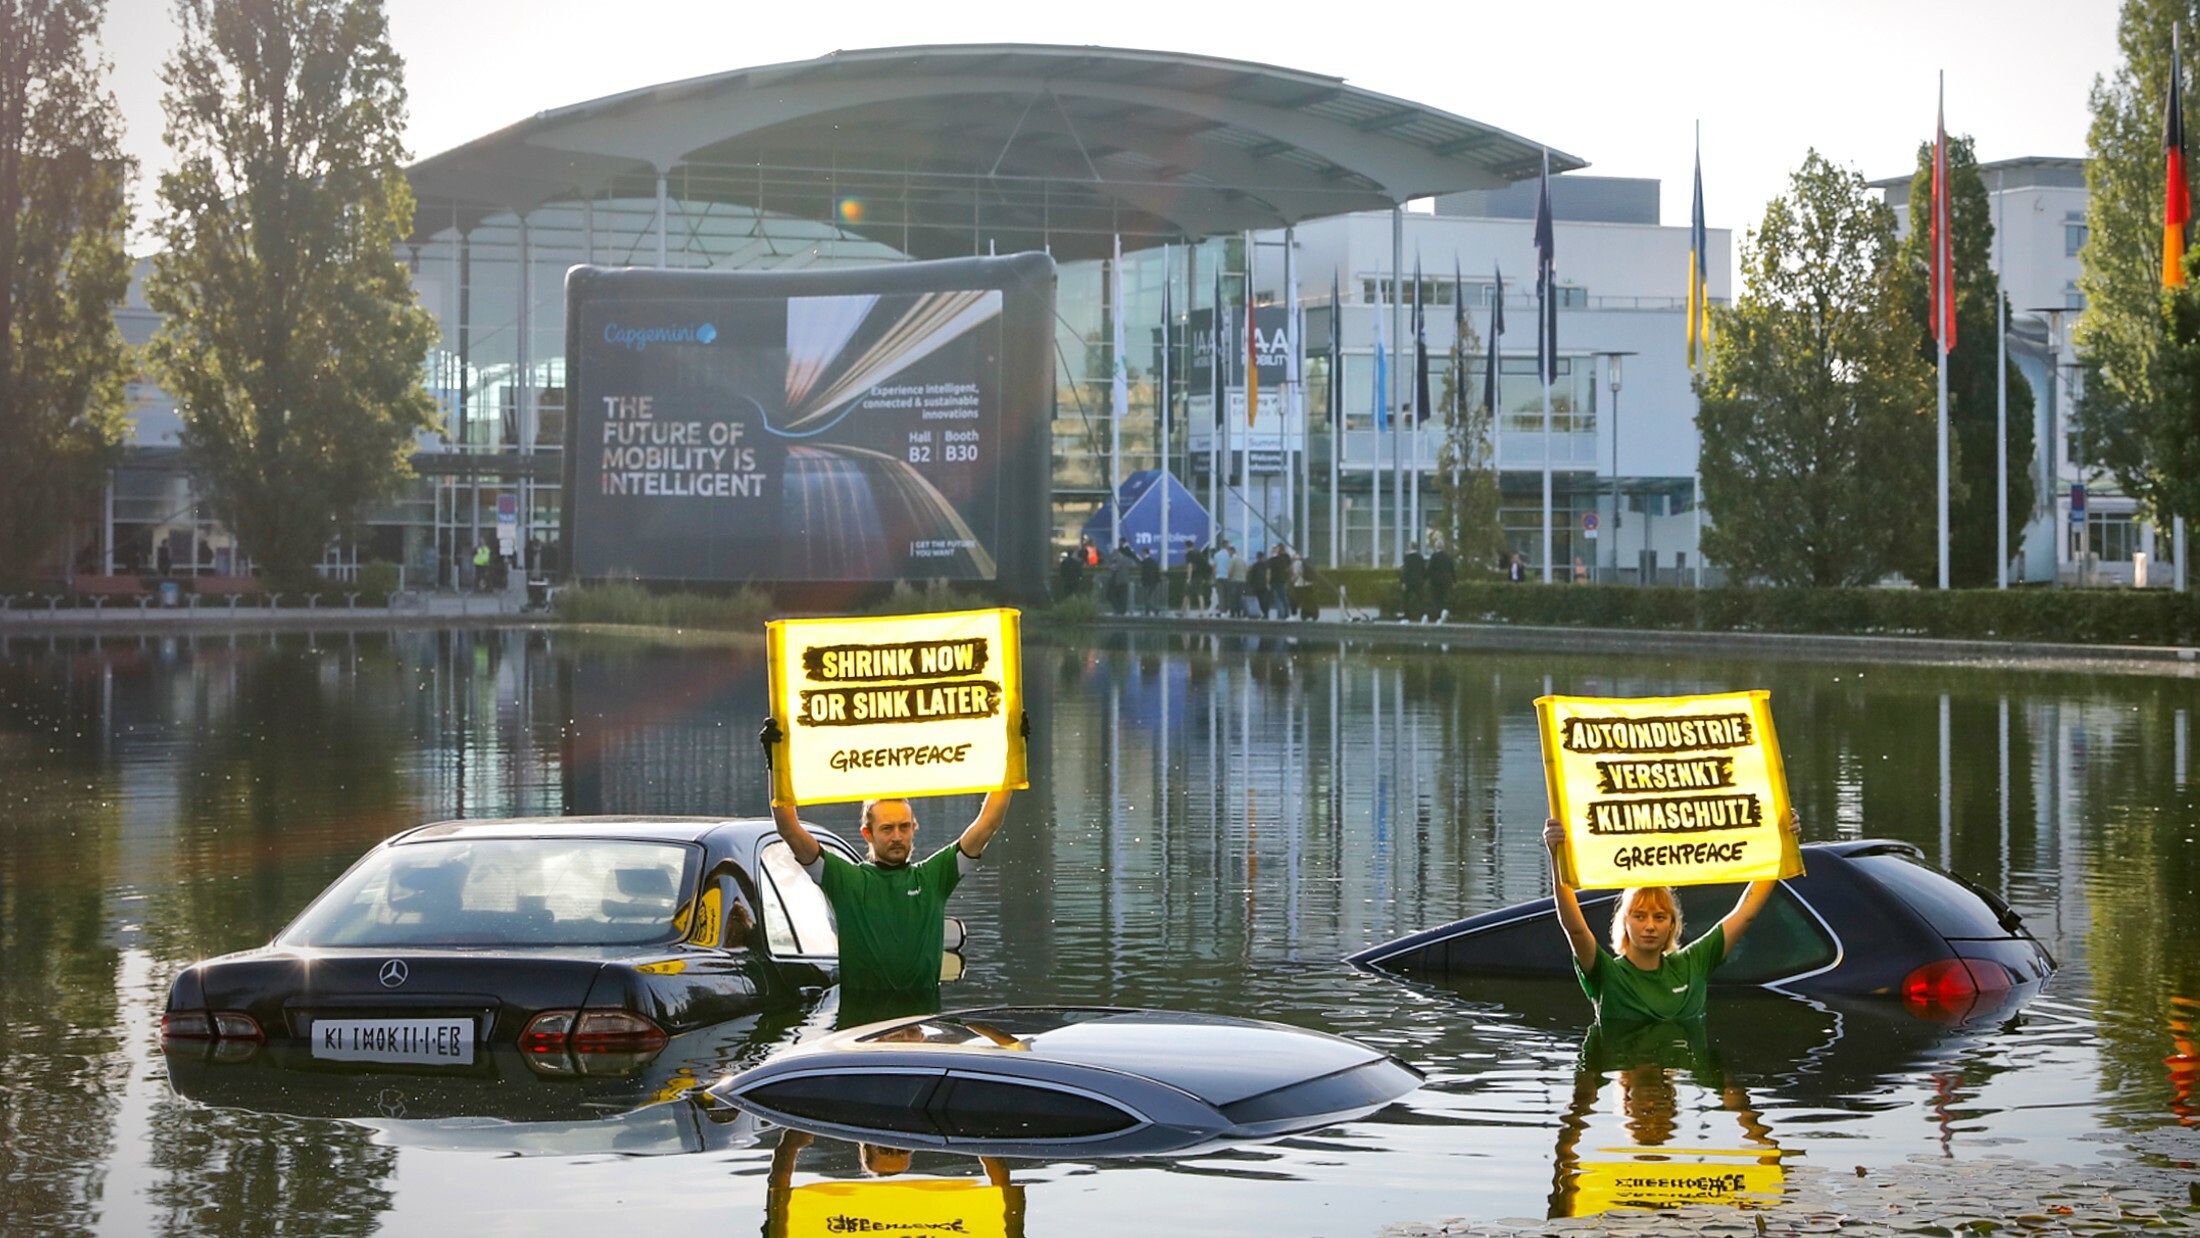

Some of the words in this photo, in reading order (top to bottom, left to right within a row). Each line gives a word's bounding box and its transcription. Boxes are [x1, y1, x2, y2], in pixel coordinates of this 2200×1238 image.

[604, 321, 694, 350] Capgemini
[863, 397, 912, 409] connected
[914, 398, 922, 407] &
[924, 395, 979, 407] sustainable
[871, 385, 924, 397] Experience
[926, 382, 979, 395] intelligent,
[603, 396, 653, 419] THE
[922, 408, 979, 419] innovations
[603, 421, 702, 445] FUTURE
[708, 421, 745, 446] OF
[909, 431, 932, 442] Hall
[944, 429, 979, 442] Booth
[602, 446, 726, 471] MOBILITY
[733, 447, 756, 471] IS
[909, 446, 931, 463] B2
[945, 444, 978, 462] B30
[602, 471, 767, 497] INTELLIGENT
[915, 541, 930, 549] GET
[947, 540, 977, 548] FUTURE
[915, 549, 931, 557] YOU
[932, 549, 955, 557] WANT
[821, 648, 914, 679] SHRINK
[921, 643, 974, 674] NOW
[810, 693, 846, 722] OR
[853, 689, 911, 720] SINK
[916, 685, 989, 716] LATER
[1572, 718, 1746, 750] AUTOINDUSTRIE
[830, 743, 972, 773] GREENPEACE
[1607, 760, 1721, 790] VERSENKT
[1595, 798, 1753, 832] KLIMASCHUTZ
[1613, 840, 1748, 871] GREENPEACE
